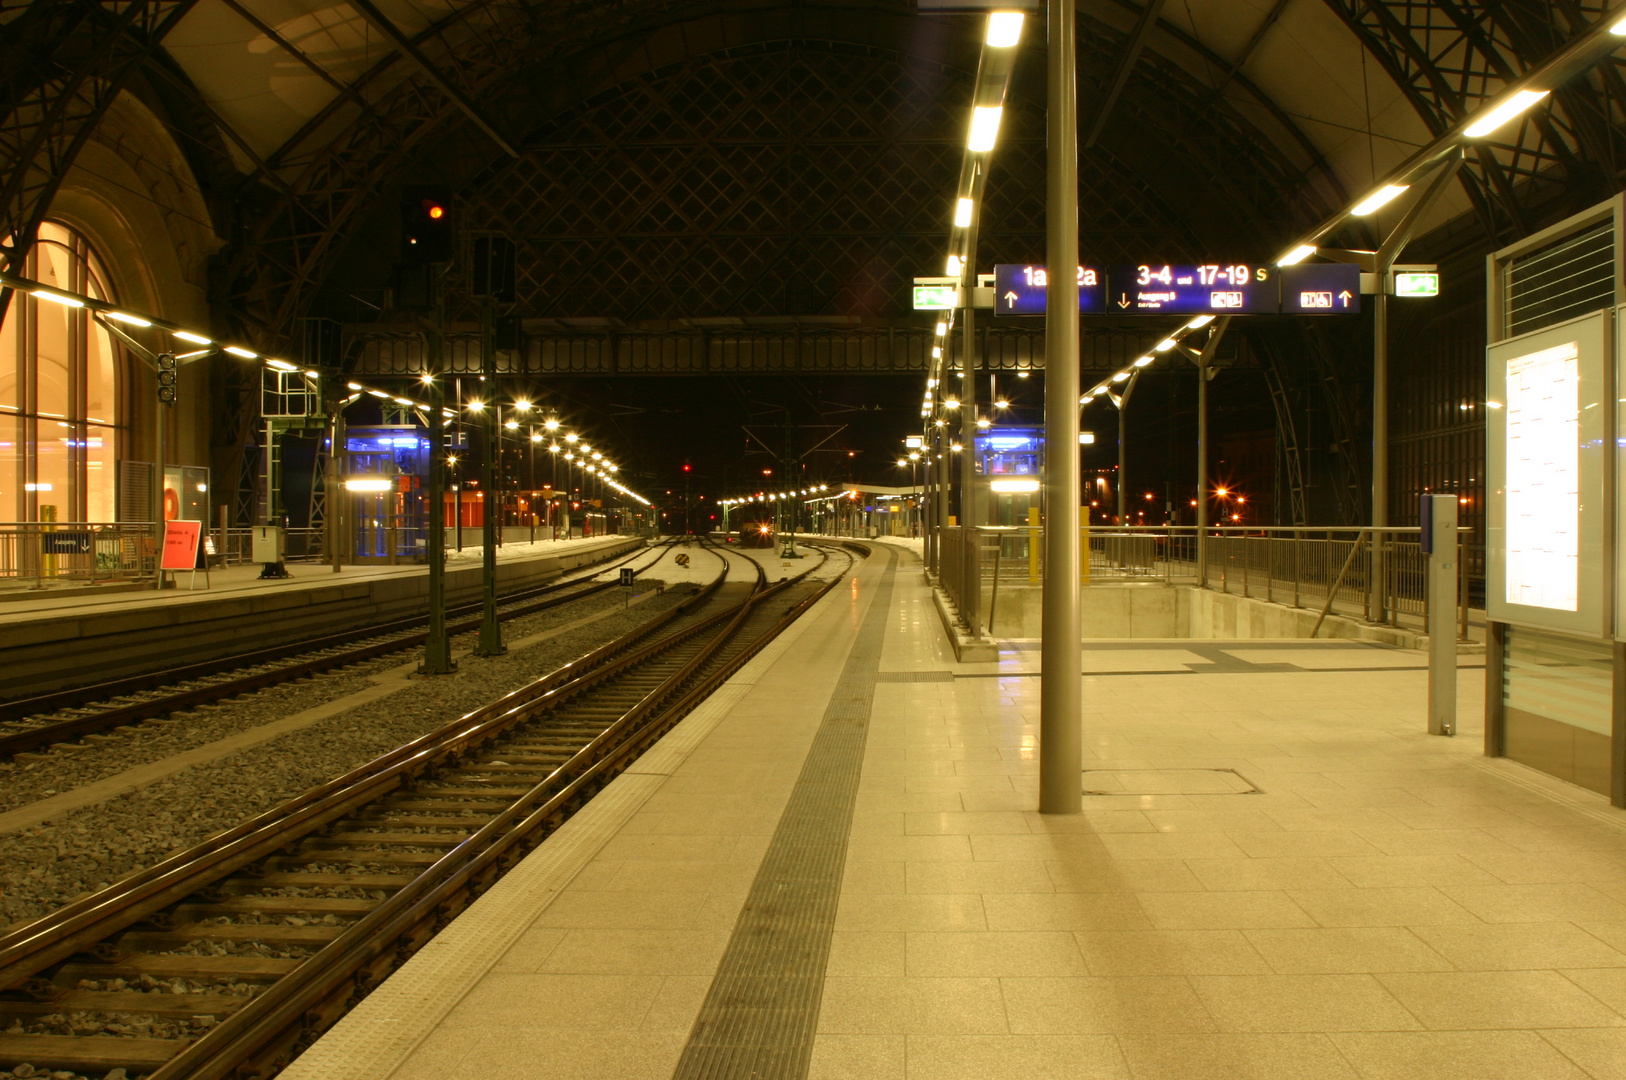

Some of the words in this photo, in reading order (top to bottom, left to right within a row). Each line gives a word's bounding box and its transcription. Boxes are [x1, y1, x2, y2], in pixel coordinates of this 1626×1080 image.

[1023, 266, 1047, 286] 1a
[1137, 265, 1172, 285] 3-4
[1197, 265, 1249, 285] 17-19
[1256, 268, 1267, 281] S
[1138, 292, 1169, 302] Ausgang
[458, 432, 467, 446] F
[621, 570, 632, 584] H
